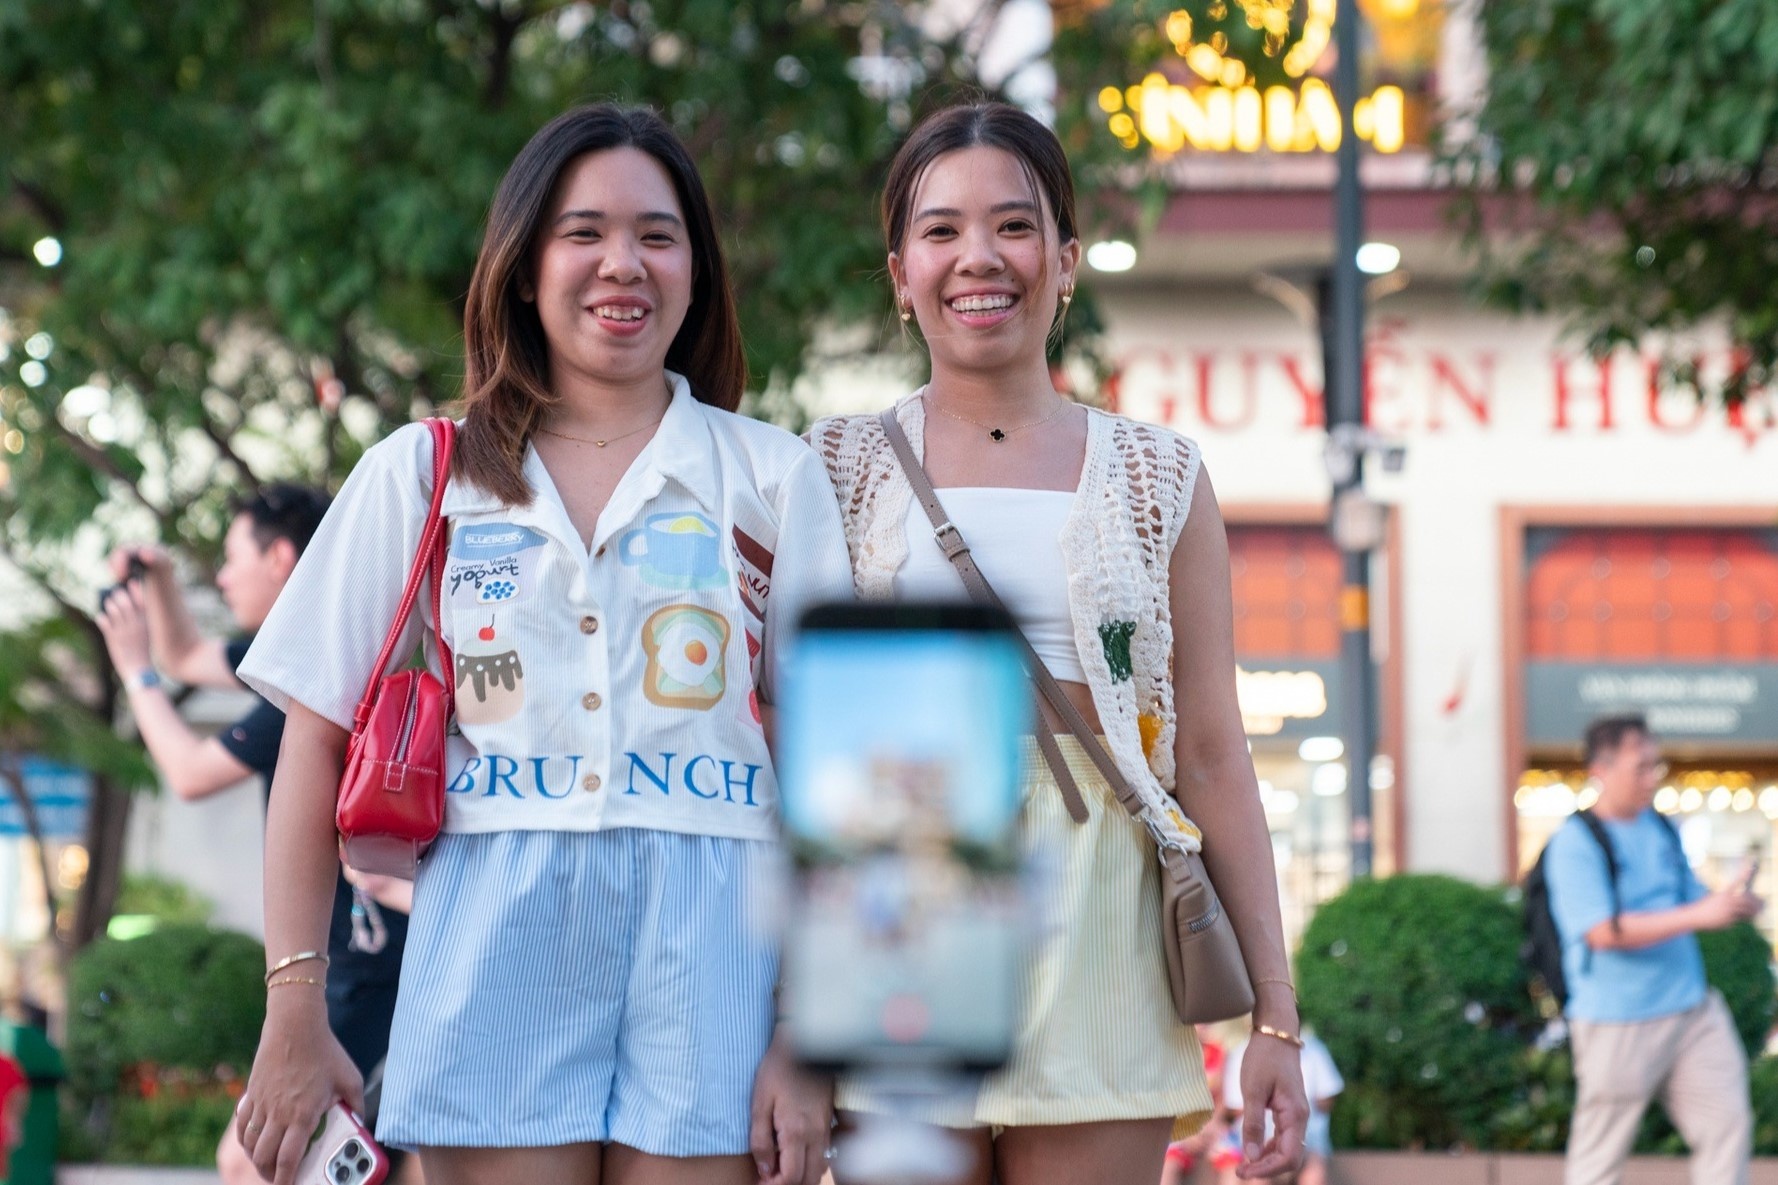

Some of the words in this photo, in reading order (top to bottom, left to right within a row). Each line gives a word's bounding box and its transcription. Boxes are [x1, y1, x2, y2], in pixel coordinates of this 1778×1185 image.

[1053, 318, 1494, 431] GUYỄN
[450, 563, 485, 573] Creamy
[489, 556, 518, 567] Vanilla
[450, 563, 519, 596] yogurt
[446, 751, 763, 807] BRUNCH
